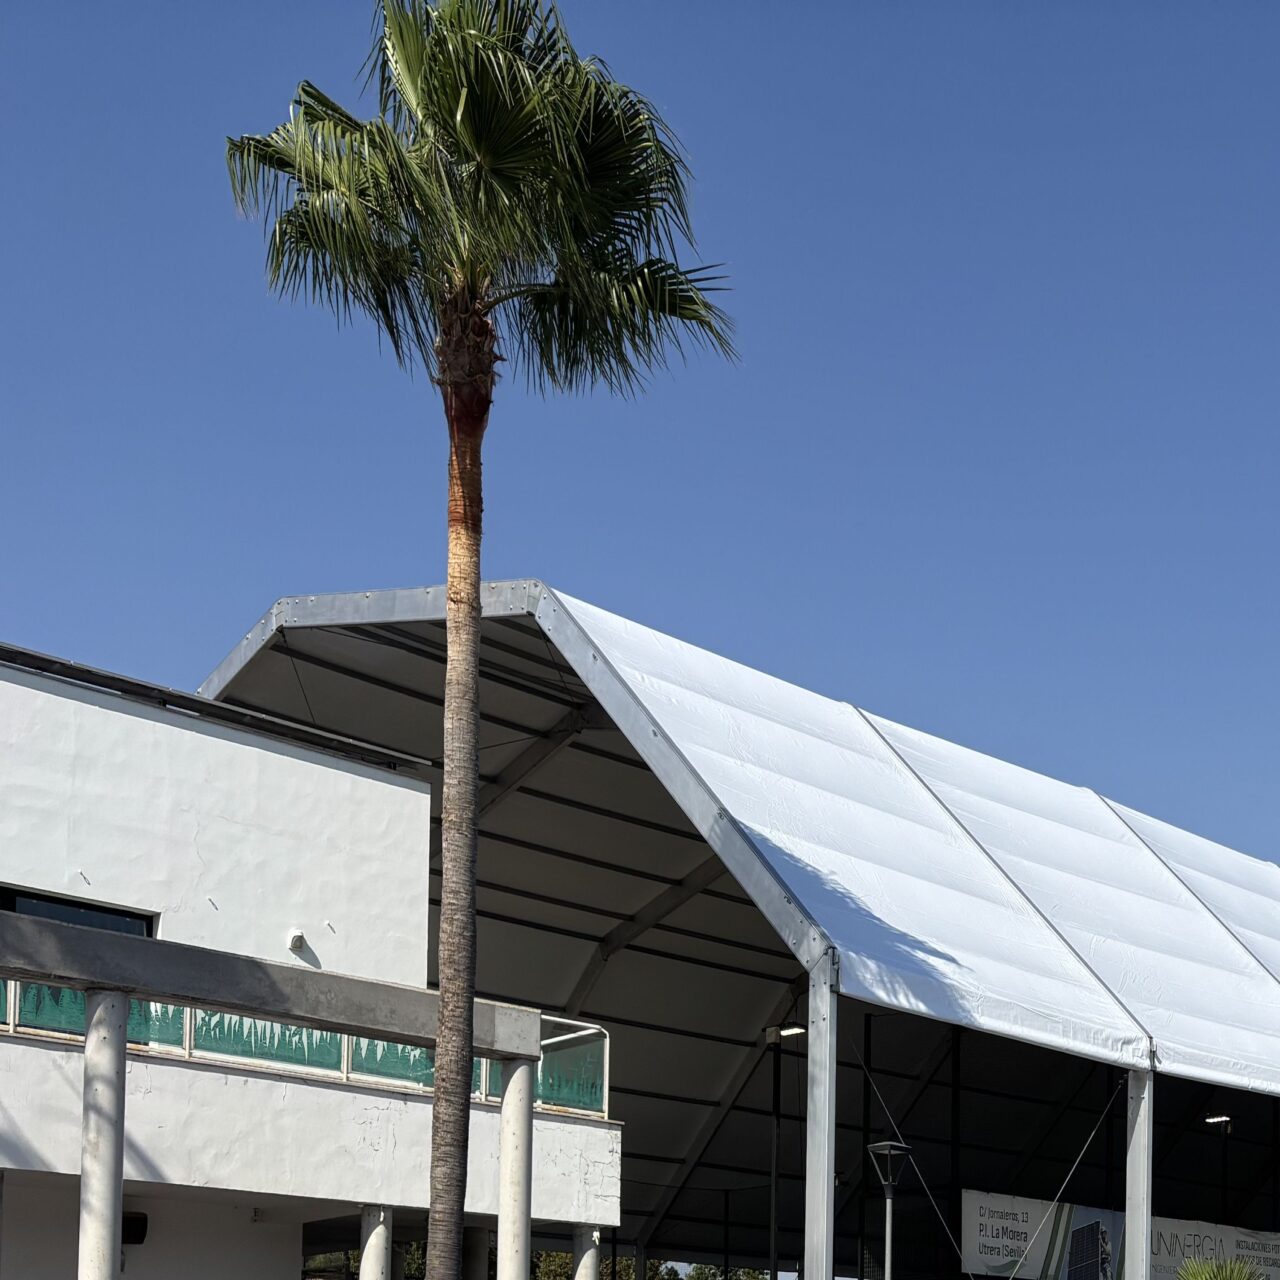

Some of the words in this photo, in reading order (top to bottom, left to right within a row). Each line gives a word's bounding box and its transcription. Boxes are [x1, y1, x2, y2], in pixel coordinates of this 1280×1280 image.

[1021, 1212, 1029, 1223] 13
[991, 1225, 1000, 1238] La
[1001, 1226, 1028, 1242] Morera
[978, 1242, 1001, 1256] Utrera
